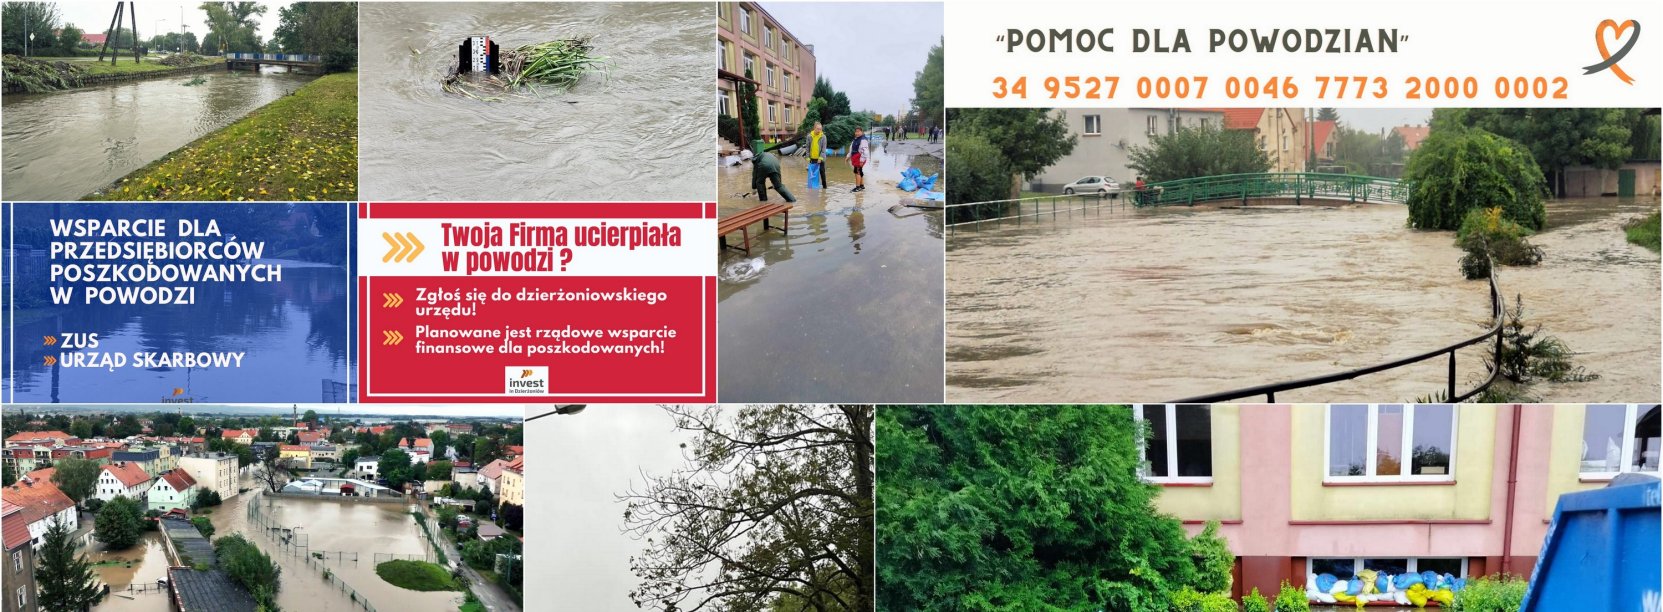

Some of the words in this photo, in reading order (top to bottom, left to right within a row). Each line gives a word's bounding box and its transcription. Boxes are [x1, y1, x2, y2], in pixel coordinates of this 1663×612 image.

[1132, 28, 1192, 53] DLA
[992, 76, 1027, 99] 34
[1043, 76, 1120, 99] 9527
[1136, 76, 1208, 99] 0007
[1225, 76, 1299, 99] 0046
[1315, 76, 1388, 99] 7773
[1405, 76, 1479, 99] 2000
[1494, 76, 1569, 99] 0002
[50, 219, 166, 237] WSPARCIE
[178, 219, 222, 237] DLA
[441, 222, 503, 249] Twoja
[509, 222, 567, 247] Firma
[574, 222, 682, 251] ucierpiała
[50, 236, 265, 264] PRZEDSIĘBIORCÓW
[441, 252, 460, 272] w
[466, 248, 553, 275] powodzi
[560, 248, 573, 272] ?
[50, 264, 282, 282] POSZKODOWANYCH
[50, 287, 73, 305] W
[85, 286, 195, 305] POWODZI
[415, 288, 461, 305] Zgłoś
[465, 288, 487, 304] się
[491, 288, 512, 302] do
[515, 288, 668, 305] dzierżoniowskiego
[415, 303, 477, 318] urzędu!
[61, 332, 99, 349] ZUS
[415, 325, 501, 339] Planowane
[503, 325, 532, 343] jest
[535, 325, 604, 342] rządowe
[607, 326, 677, 342] wsparcie
[415, 340, 495, 354] finansowe
[498, 340, 523, 354] dla
[527, 340, 665, 356] poszkodowanych!
[60, 352, 127, 371] URZĄD
[132, 352, 245, 368] SKARBOWY
[509, 378, 544, 388] invest
